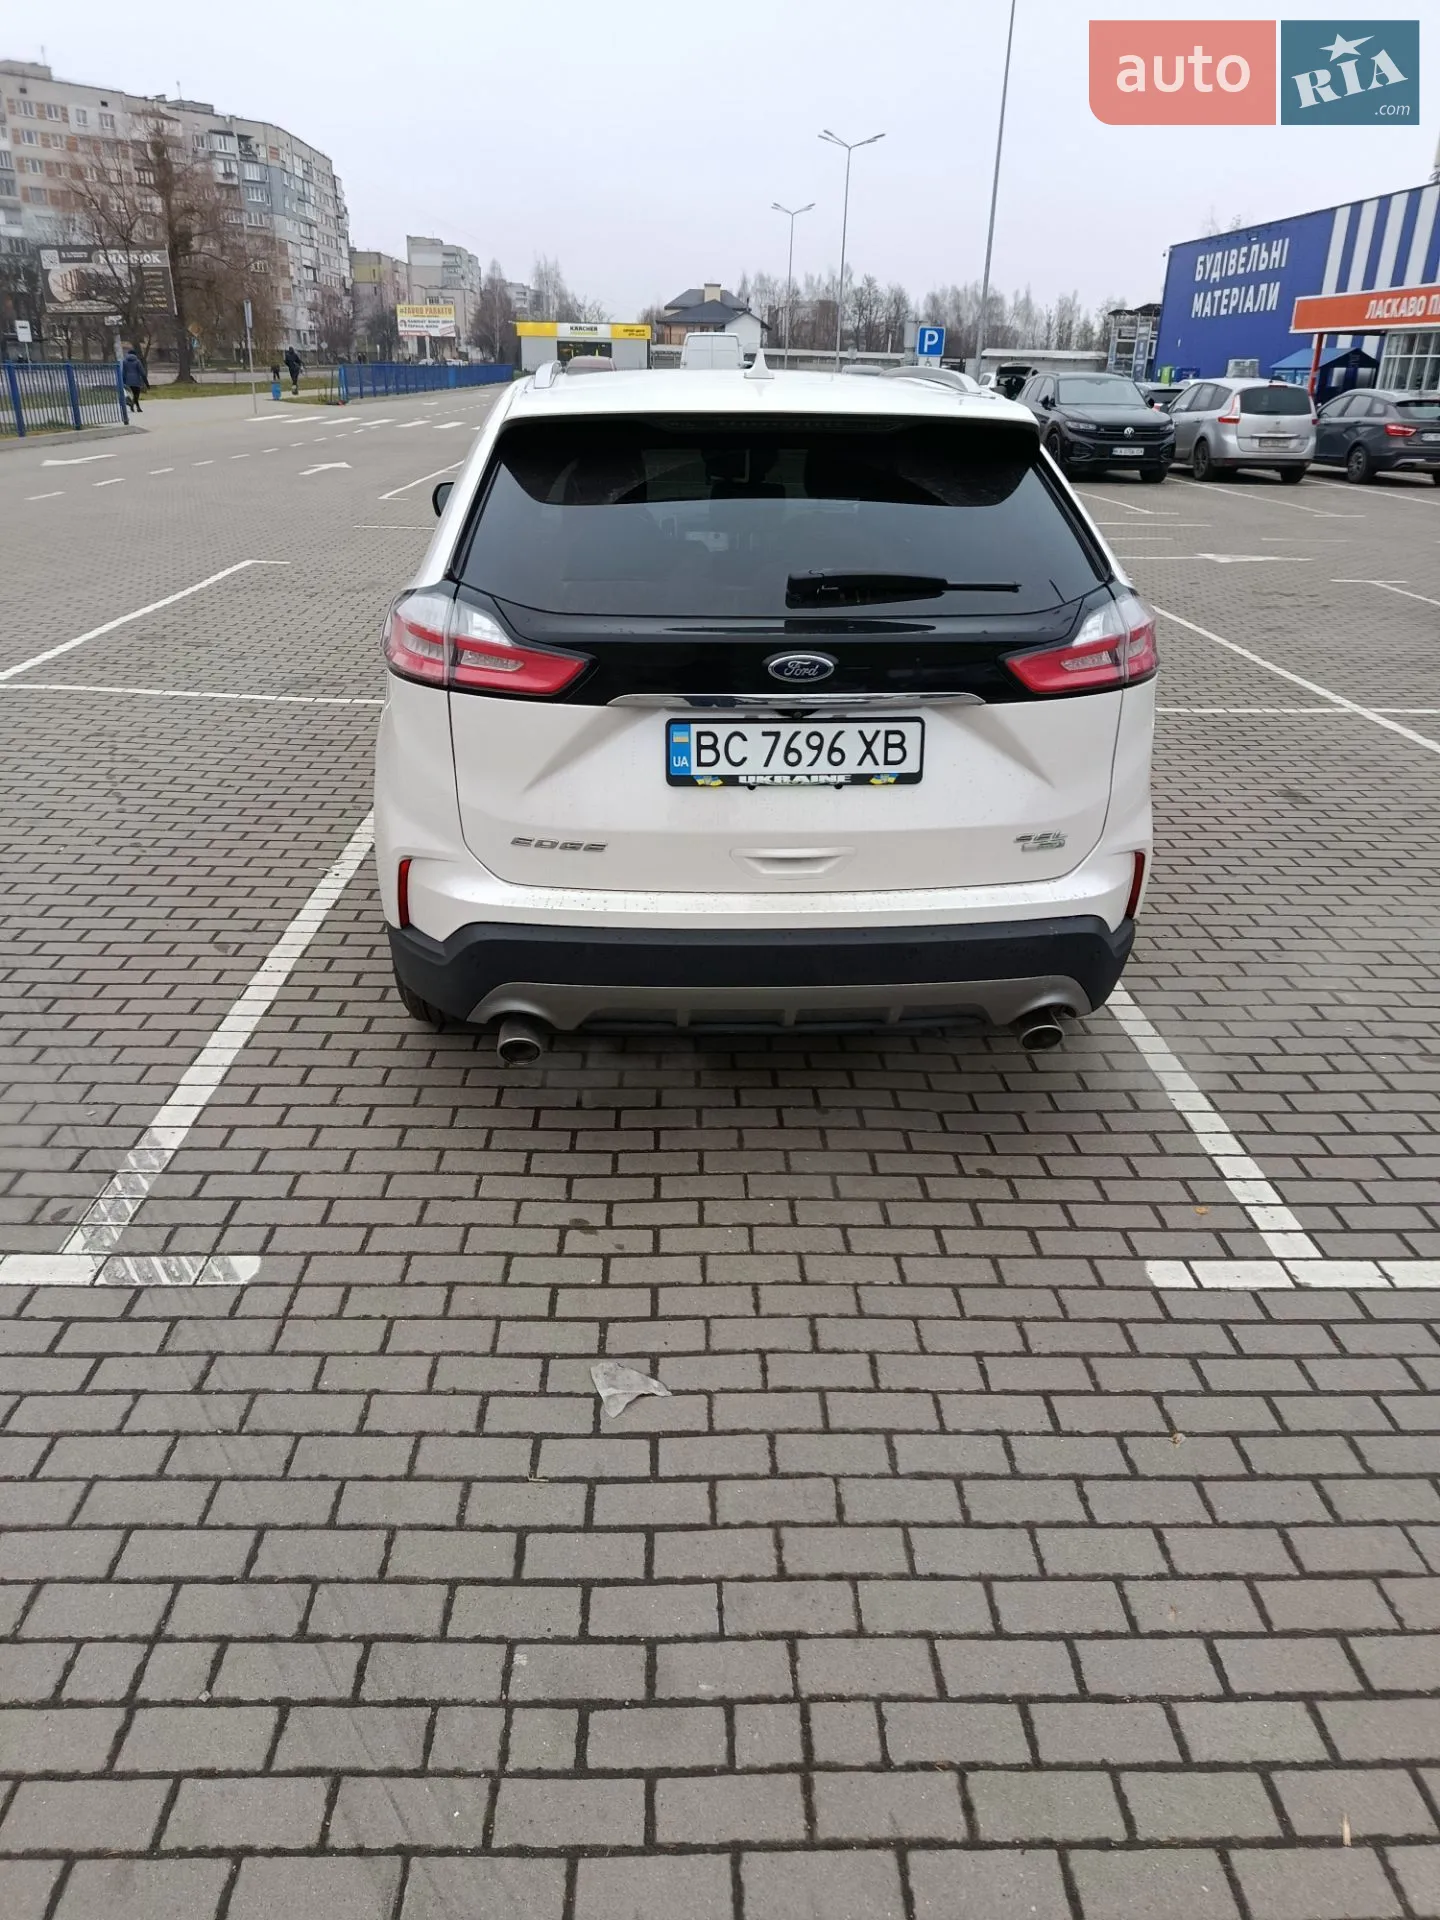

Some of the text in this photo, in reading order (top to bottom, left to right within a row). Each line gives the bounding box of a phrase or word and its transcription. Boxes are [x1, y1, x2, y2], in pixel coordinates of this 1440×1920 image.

[1194, 237, 1290, 283] БУДІВЕЛЬНІ
[1190, 281, 1281, 319] МАТЕРІАЛИ
[1364, 295, 1427, 319] ЛАСКАВО
[923, 329, 939, 353] P
[784, 660, 819, 677] Ford
[695, 729, 907, 768] BC 7696 XB
[672, 756, 689, 768] UA
[737, 774, 852, 785] UKRAINE
[510, 836, 608, 853] EDGE
